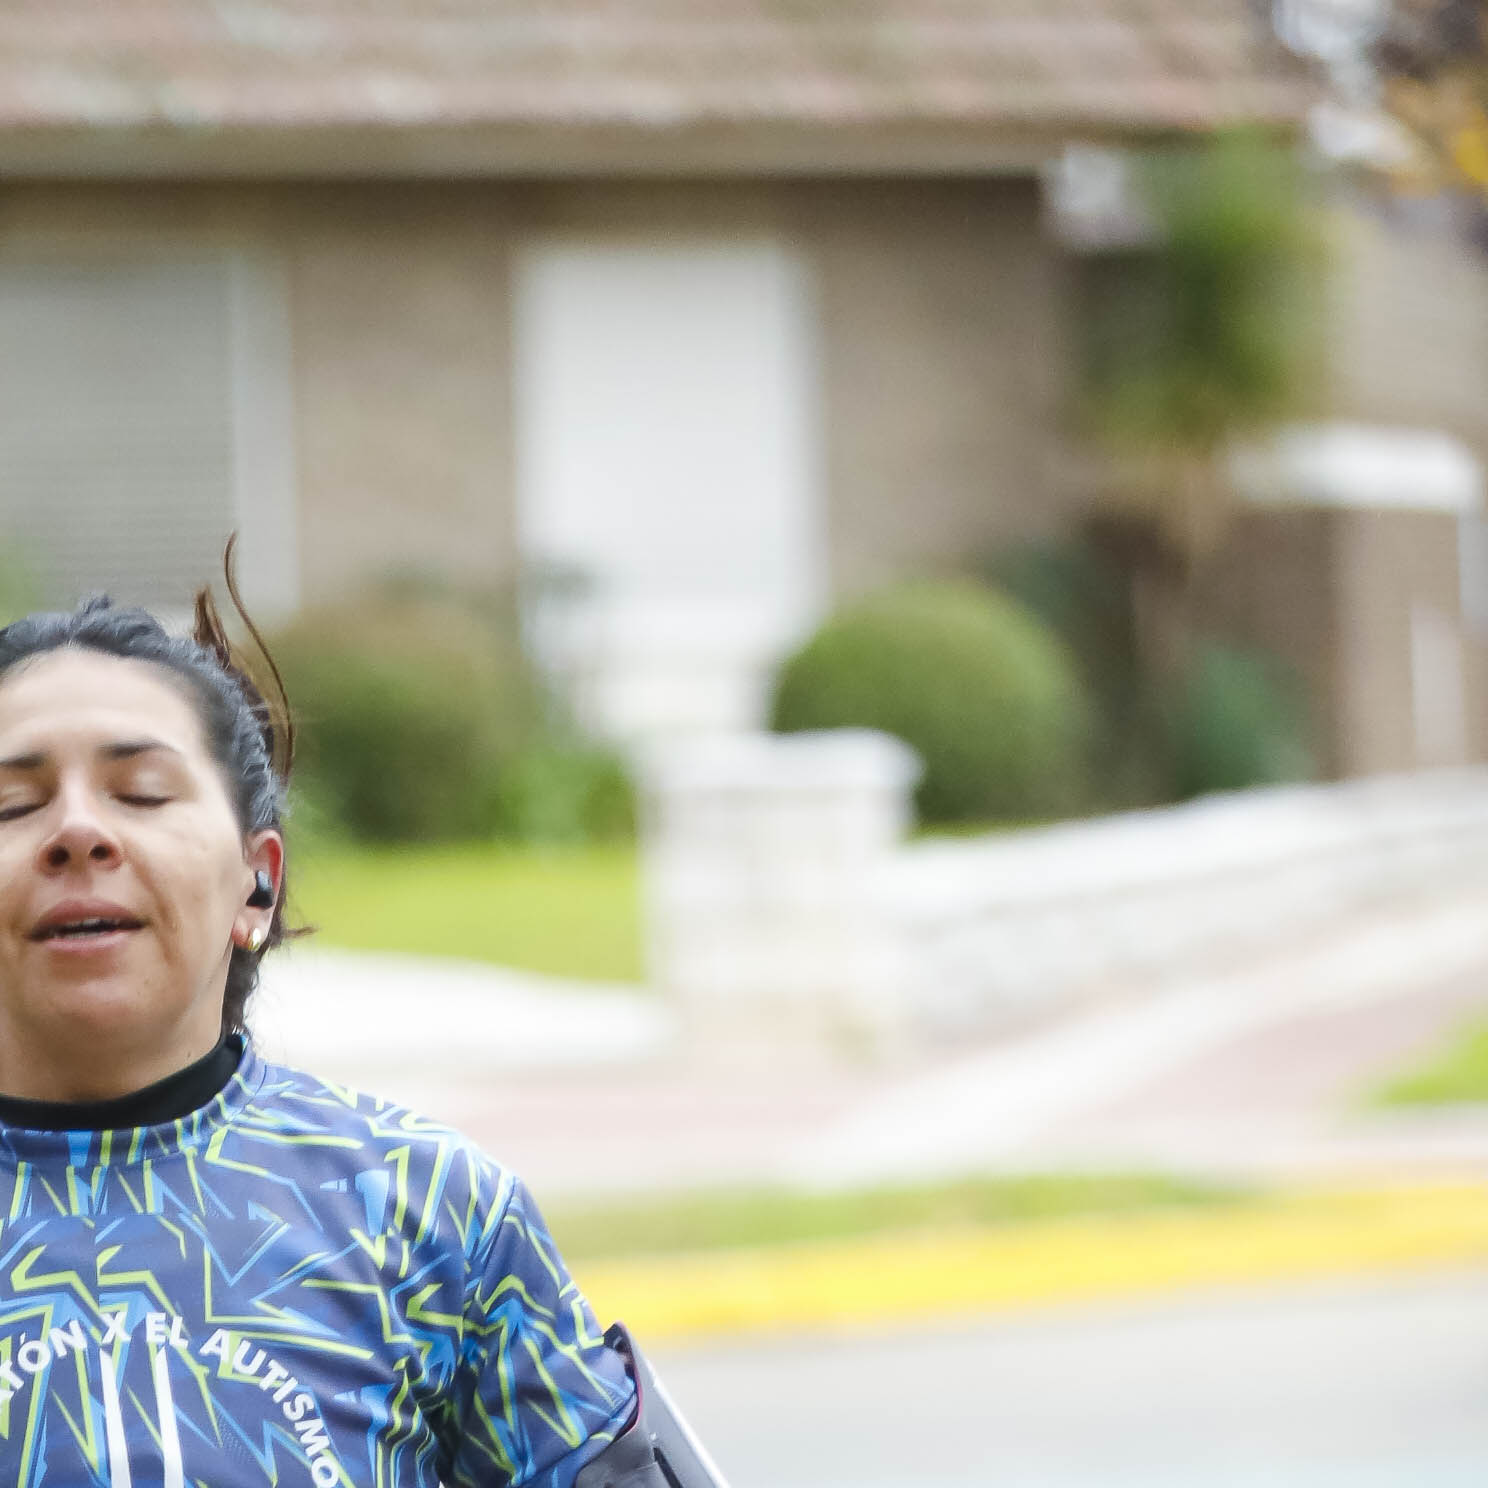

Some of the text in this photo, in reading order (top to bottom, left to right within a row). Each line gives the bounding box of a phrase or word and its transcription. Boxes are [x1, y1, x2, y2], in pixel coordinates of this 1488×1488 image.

[102, 1311, 131, 1343] X
[145, 1312, 189, 1348] EL
[199, 1328, 339, 1488] AUTISMO
